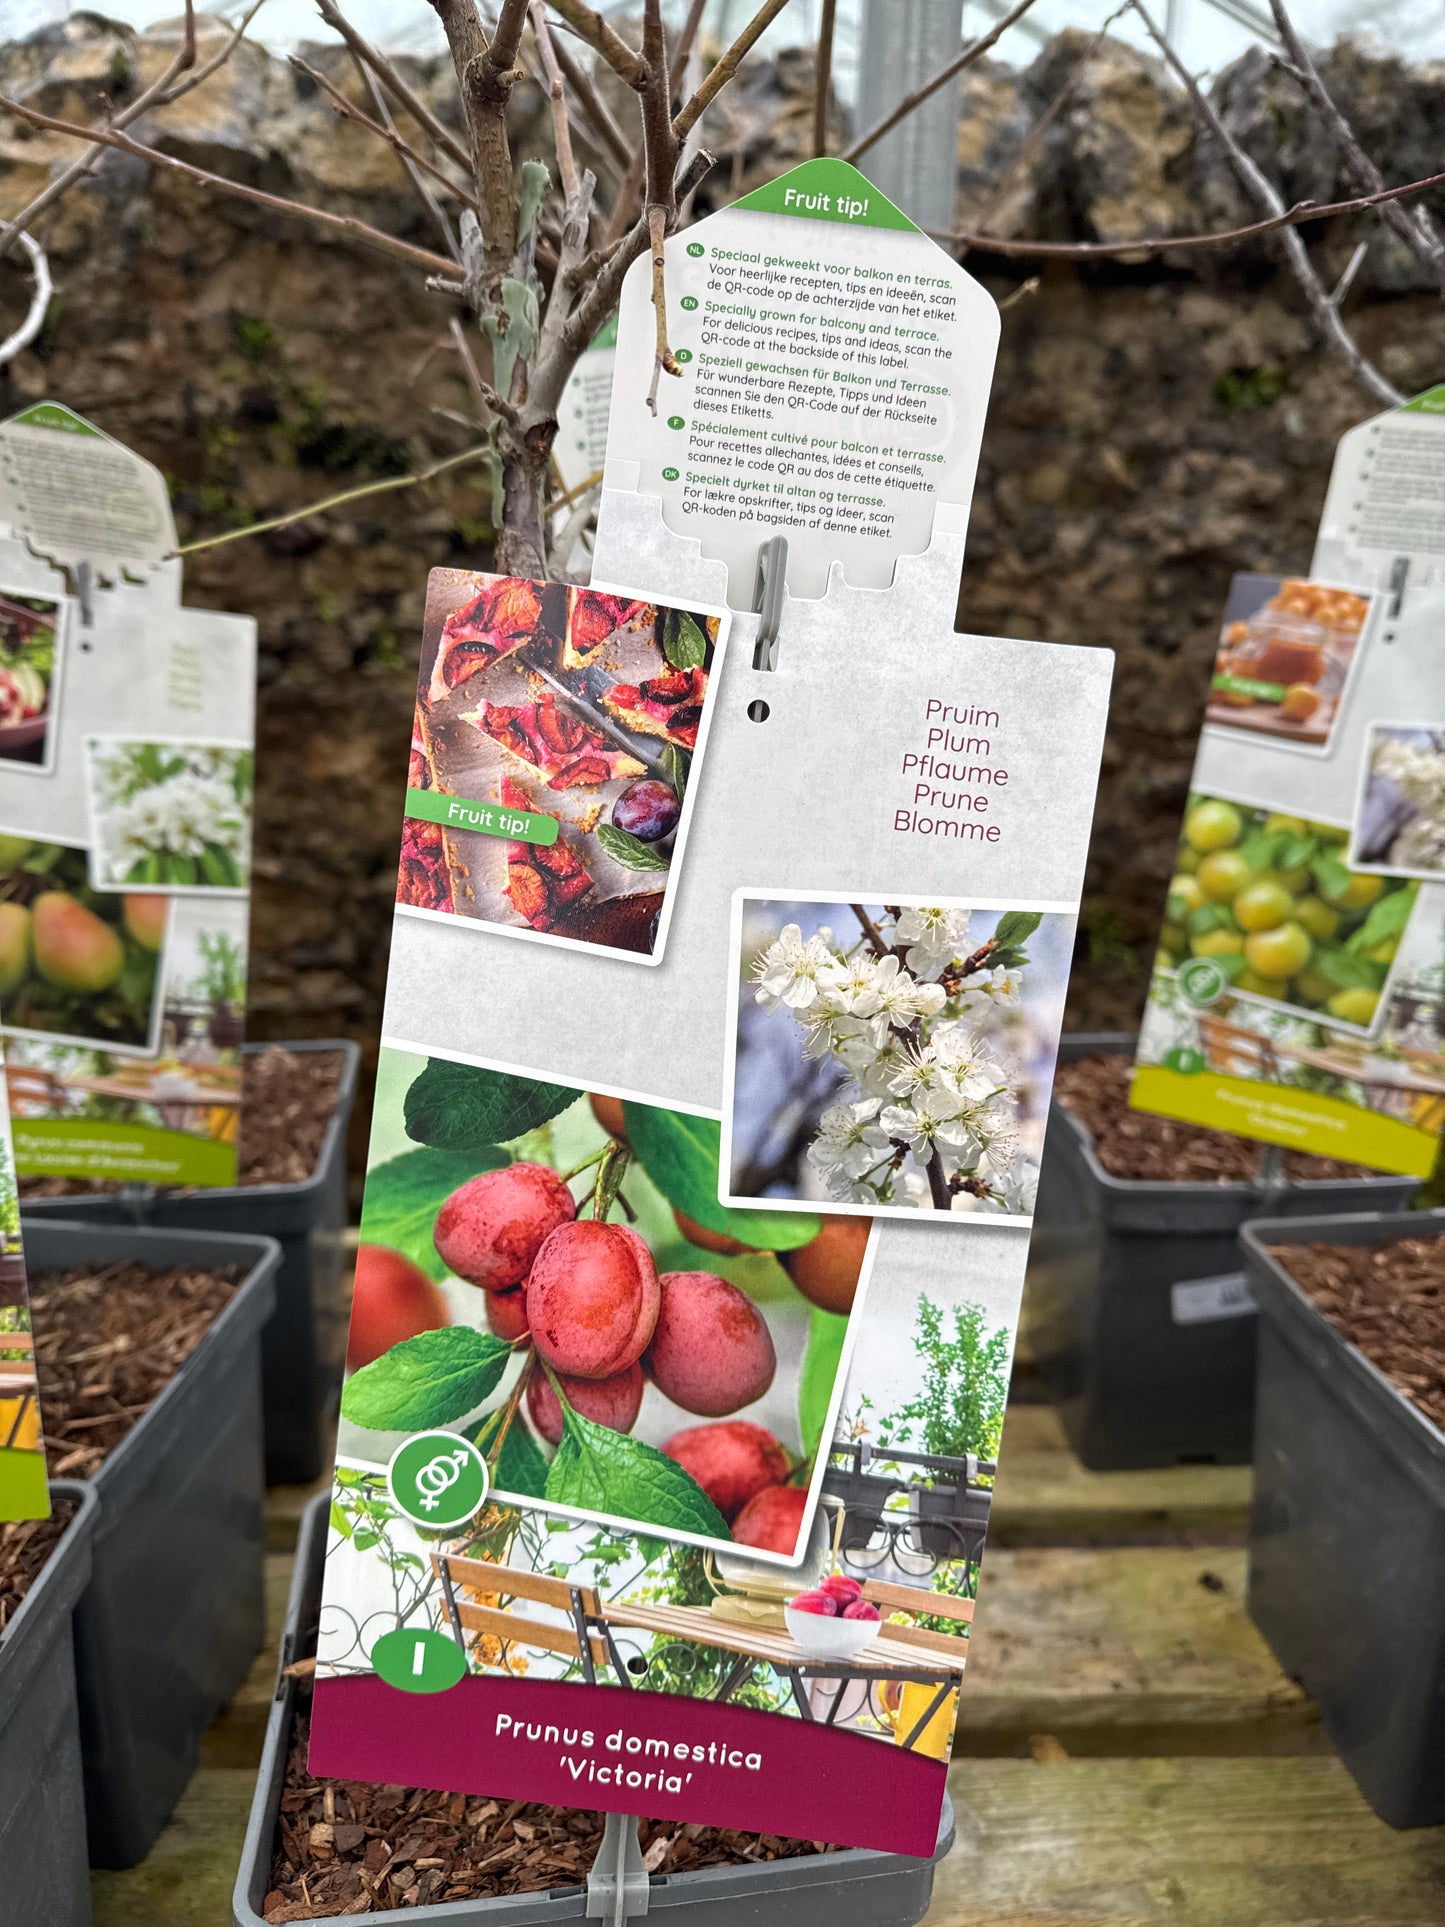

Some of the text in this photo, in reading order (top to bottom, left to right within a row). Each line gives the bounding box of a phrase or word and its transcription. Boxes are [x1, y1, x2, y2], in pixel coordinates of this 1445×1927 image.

[784, 188, 869, 219] Fruit tip!
[689, 245, 952, 289] NL Speciaal gekweekt voor balkon en terras.
[709, 263, 956, 306] Voor heerlijke recepten, tips en ideeën, scan
[707, 279, 957, 322] de QR-code op de achterzijde van het etiket.
[683, 299, 939, 342] EN Specially grown for balcony and terrace.
[703, 316, 952, 359] For delicious recipes, tips and ideas, scan the
[701, 331, 908, 369] QR-code at the backside of this label.
[697, 368, 927, 408] Für wunderbare Rezepte, Tipps und Ideen
[699, 353, 742, 368] Speziell
[745, 361, 809, 377] gewachsen
[813, 368, 830, 380] für
[833, 371, 872, 385] Balkon
[875, 378, 897, 389] und
[900, 380, 951, 396] Terrasse.
[693, 399, 773, 419] dieses Etiketts.
[695, 386, 937, 425] scannen Sie den QR-Code auf der Rückseite
[689, 435, 924, 477] Pour recettes allechantes, idées et conseils,
[691, 420, 768, 440] Spécialement
[771, 432, 808, 445] cultivé
[811, 438, 838, 449] pour
[841, 440, 879, 454] balcon
[882, 447, 894, 456] et
[897, 448, 946, 463] terrasse.
[664, 470, 885, 507] DK Specielt dyrket til altan og terrasse.
[687, 452, 935, 492] scannez le code QR au dos de cette étiquette.
[682, 501, 892, 538] QR-koden på bagsiden af denne etiket.
[684, 486, 894, 523] For lækre opskrifter, tips og ideer, scan
[926, 699, 999, 728] Pruim
[928, 728, 990, 756] Plum
[902, 753, 1008, 786] Pflaume
[914, 783, 988, 812] Prune
[448, 803, 530, 836] Fruit tip!
[894, 809, 1001, 842] Blomme
[495, 1713, 762, 1770] Prunus domestica
[559, 1756, 693, 1793] 'Victoria'
